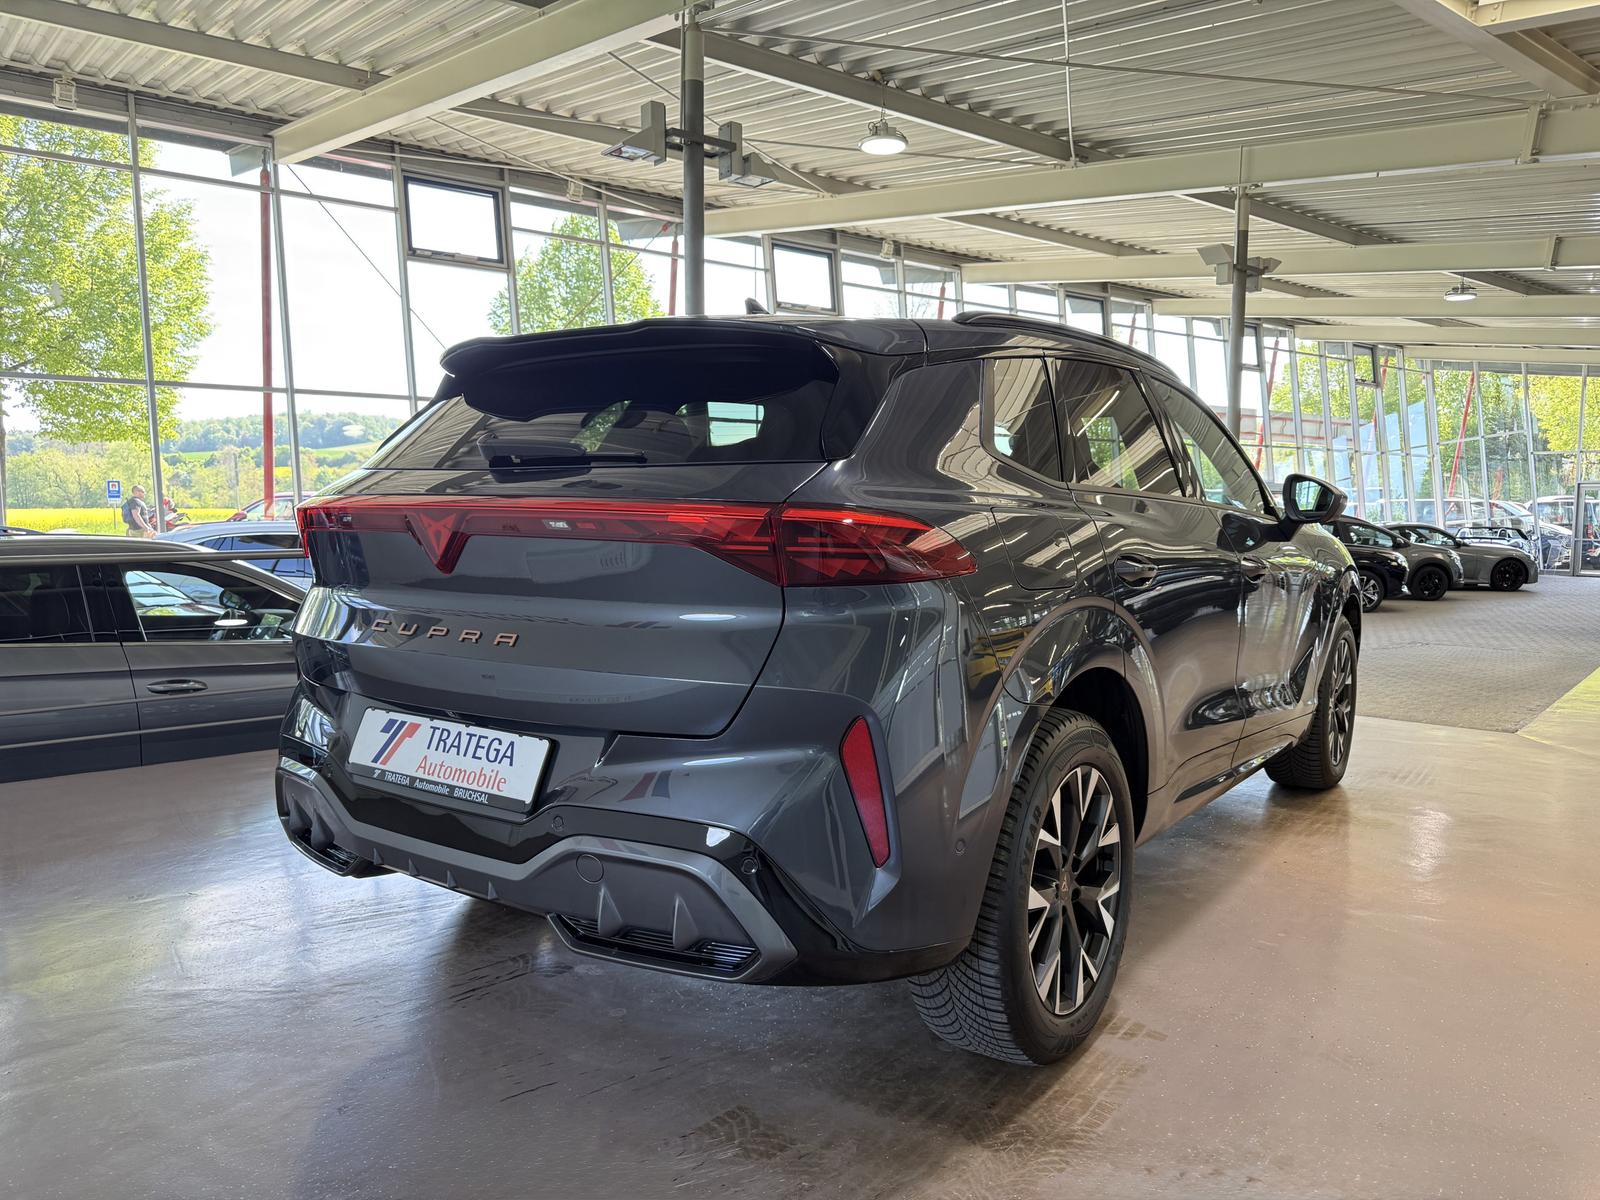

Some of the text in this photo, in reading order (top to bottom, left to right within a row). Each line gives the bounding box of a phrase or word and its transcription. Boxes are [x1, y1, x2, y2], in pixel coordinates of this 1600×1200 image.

[370, 619, 519, 647] CUPRA
[426, 725, 515, 767] TRATEGA
[384, 771, 489, 804] TRATEGA Automobile BRUCHSAL
[415, 754, 507, 792] Automobile
